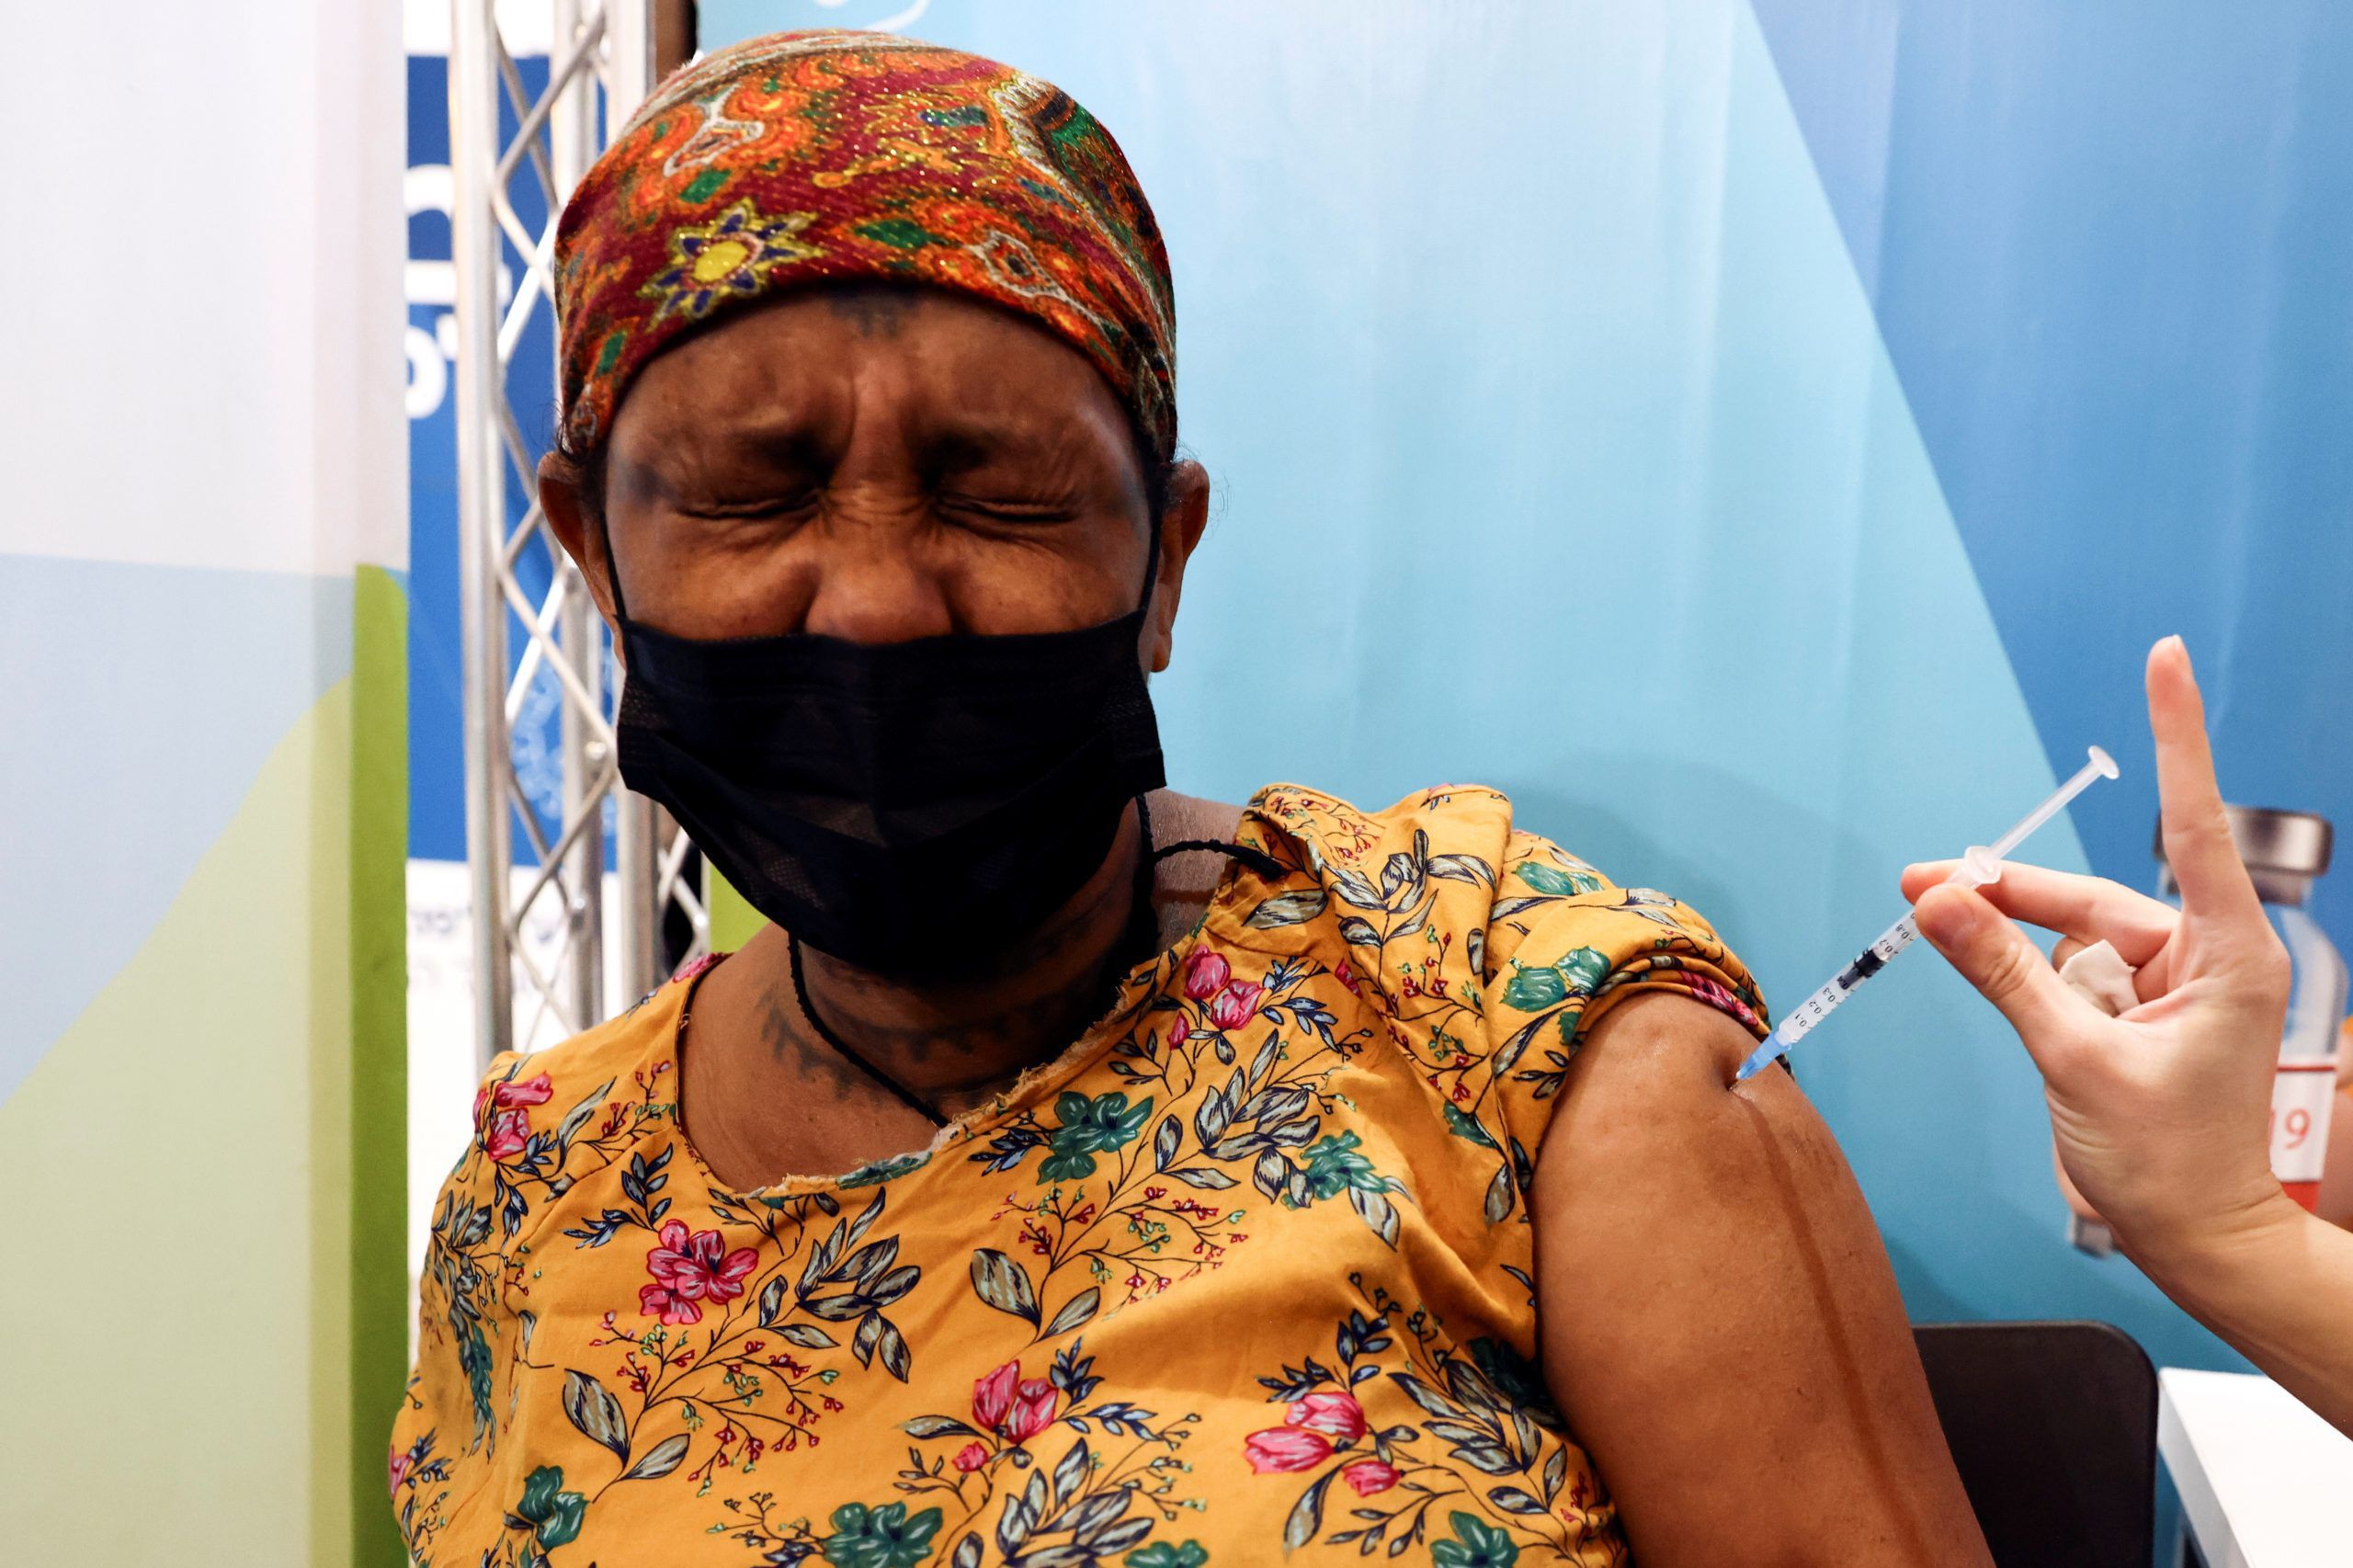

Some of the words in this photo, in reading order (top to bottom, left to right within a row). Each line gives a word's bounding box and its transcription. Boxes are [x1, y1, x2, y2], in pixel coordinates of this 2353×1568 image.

[1823, 987, 1836, 1003] 0.3
[1808, 1000, 1823, 1014] 0.2
[1795, 1013, 1807, 1028] 0.1
